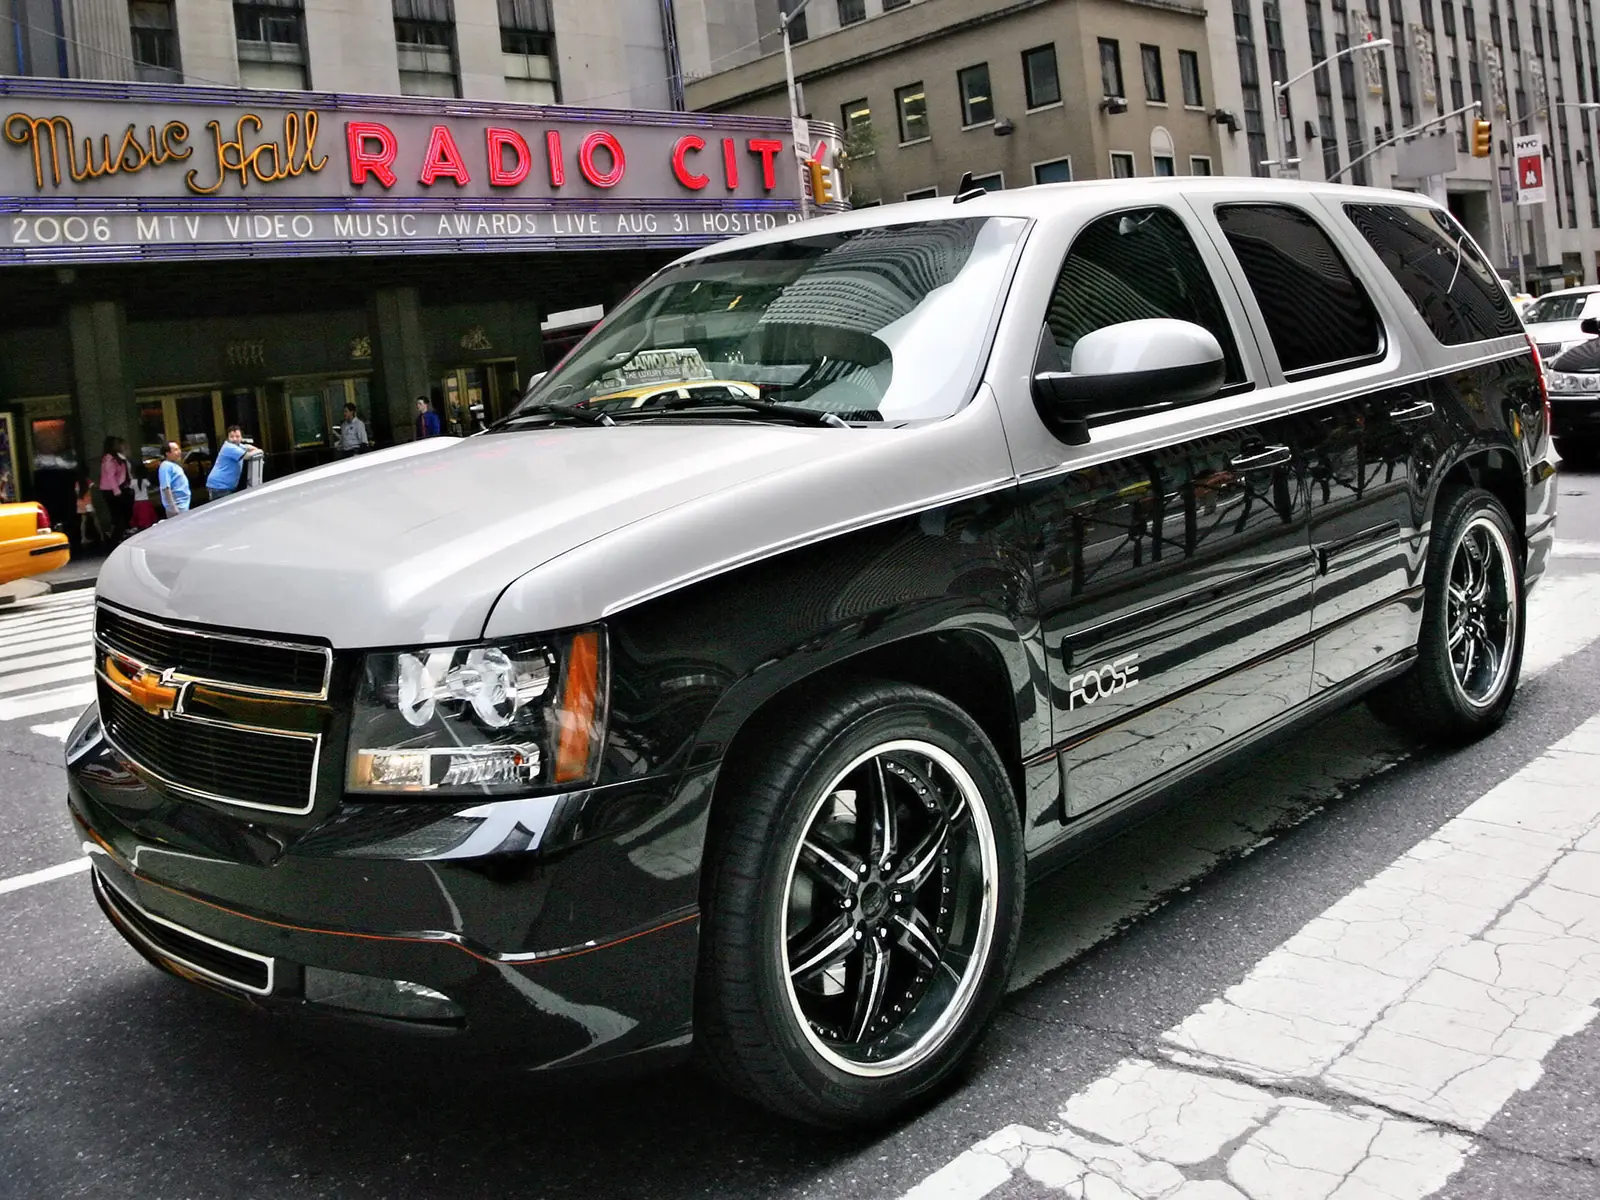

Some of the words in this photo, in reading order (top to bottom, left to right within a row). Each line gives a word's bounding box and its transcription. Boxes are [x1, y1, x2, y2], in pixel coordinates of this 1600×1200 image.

[5, 112, 193, 191] Music
[185, 109, 329, 194] Hall
[346, 120, 626, 189] RADIO
[1516, 139, 1538, 149] NYC
[13, 216, 111, 243] 2006
[136, 216, 199, 241] MTV
[225, 215, 313, 239] VIDEO
[334, 214, 417, 237] MUSIC
[437, 214, 536, 235] AWARDS
[552, 214, 600, 234] LIVE
[617, 213, 657, 233] AUG
[673, 213, 690, 232] 31
[702, 213, 776, 232] HOSTED
[624, 371, 638, 380] THE
[638, 369, 662, 379] LUXURY
[662, 367, 682, 377] ISSUE
[1069, 652, 1139, 711] FOOSE
